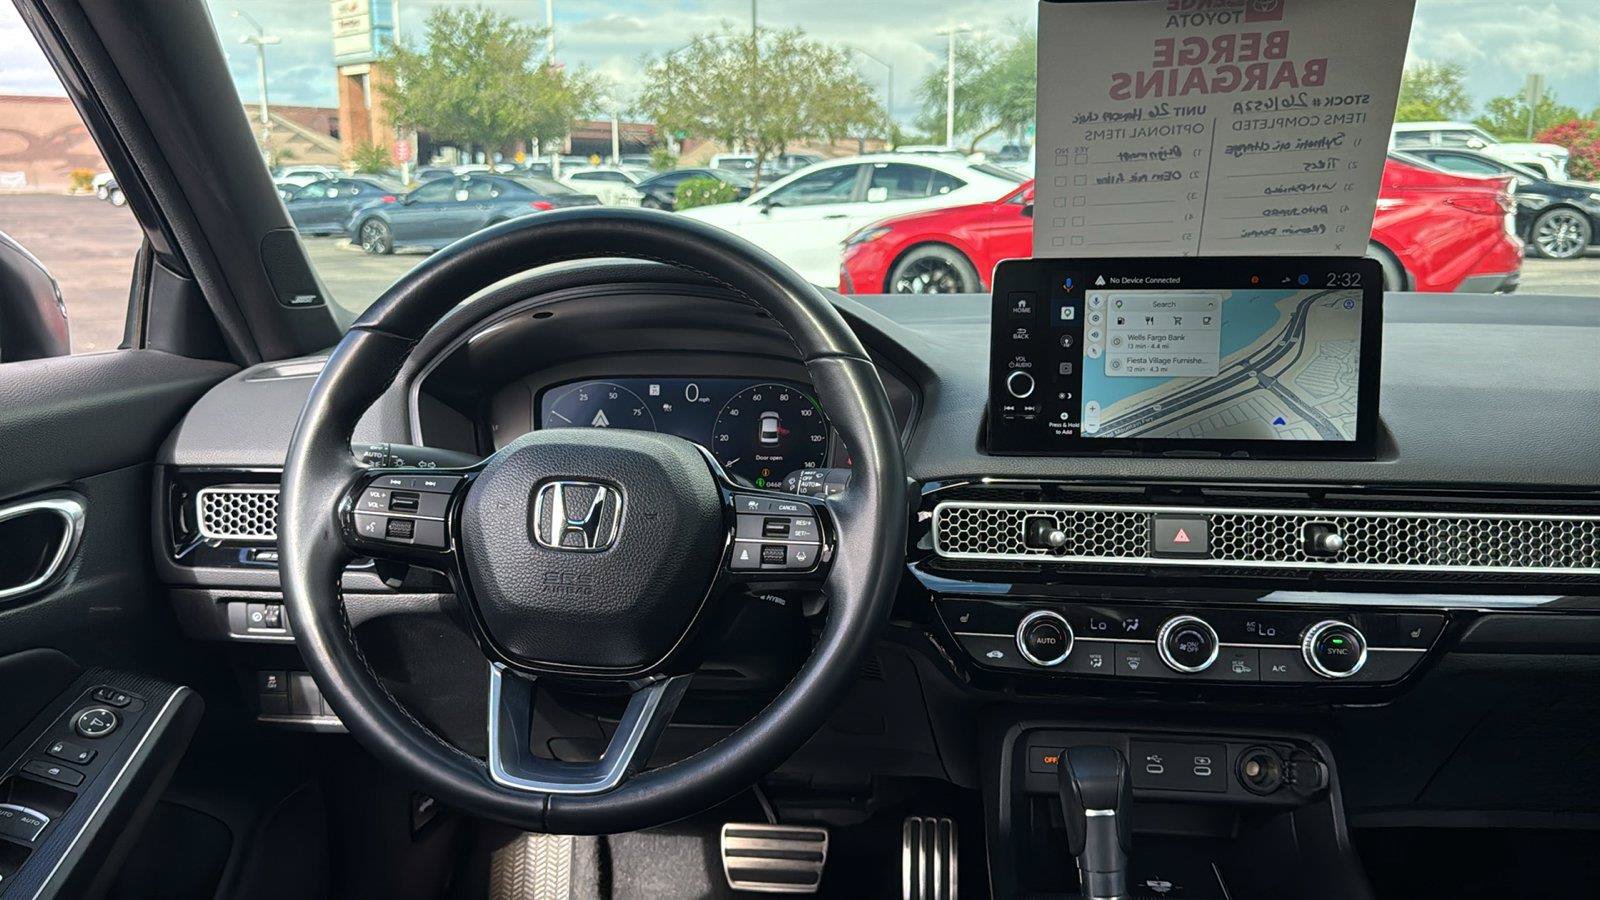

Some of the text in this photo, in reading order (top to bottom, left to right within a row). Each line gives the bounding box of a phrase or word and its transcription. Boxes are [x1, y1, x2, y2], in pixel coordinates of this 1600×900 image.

[1326, 272, 1361, 287] 2:32
[1147, 334, 1167, 343] Fargo
[1148, 357, 1171, 365] Village
[608, 392, 618, 400] 50
[685, 383, 699, 402] 0
[579, 393, 588, 401] 25
[632, 408, 642, 416] 75
[800, 409, 812, 417] 100
[720, 434, 729, 442] 20
[804, 461, 816, 469] 140
[1036, 637, 1057, 645] AUTO
[20, 816, 40, 826] AUTO
